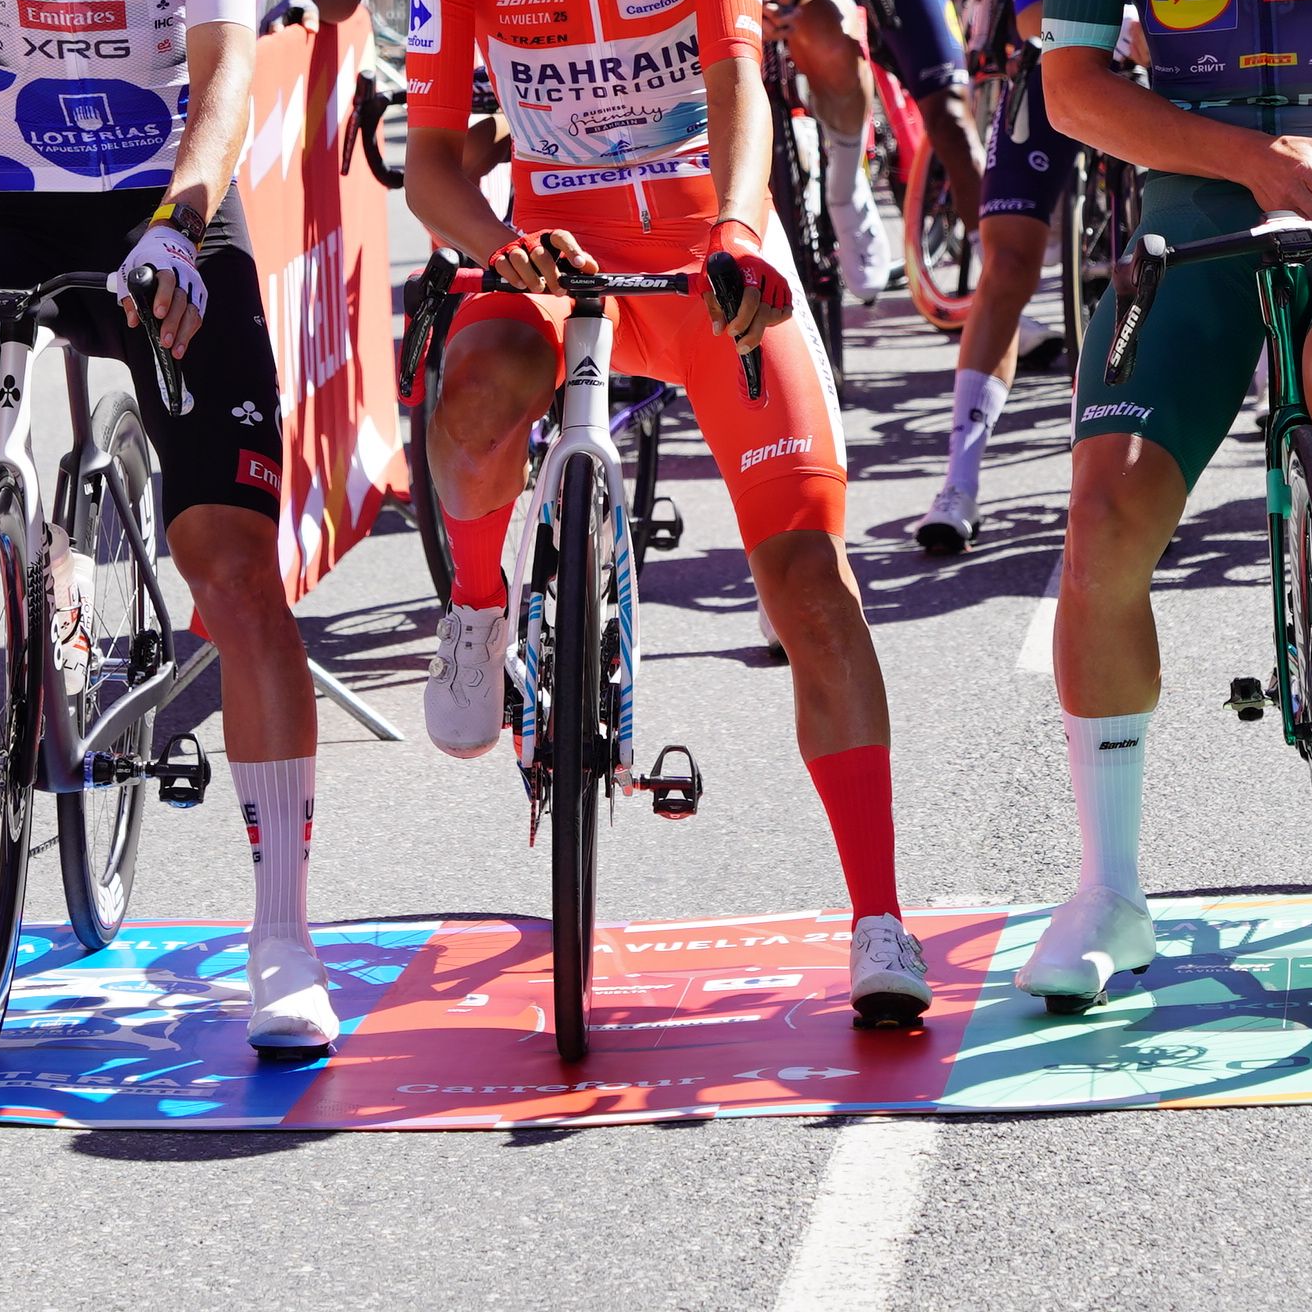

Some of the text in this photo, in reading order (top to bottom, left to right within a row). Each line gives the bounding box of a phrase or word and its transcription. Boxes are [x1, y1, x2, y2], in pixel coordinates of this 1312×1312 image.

[26, 5, 116, 28] Emirates
[154, 16, 174, 31] IHC
[499, 11, 568, 26] LA VUELTA 25
[22, 36, 131, 60] XRG
[510, 34, 700, 86] BAHRAIN
[1190, 62, 1226, 74] CRIVIT
[515, 60, 703, 103] VICTORIOUS
[31, 123, 161, 146] LOTERÍAS
[45, 144, 98, 153] APUESTAS
[100, 141, 120, 152] DEL
[122, 136, 164, 148] ESTADO
[542, 160, 680, 191] Carrefour
[1109, 304, 1141, 369] SRAM
[566, 378, 605, 388] MERIDA
[1081, 400, 1155, 423] Santini
[740, 434, 814, 474] Santini
[1098, 735, 1141, 753] Santini
[625, 935, 793, 954] VUELTA
[395, 1074, 706, 1096] Carrefour
